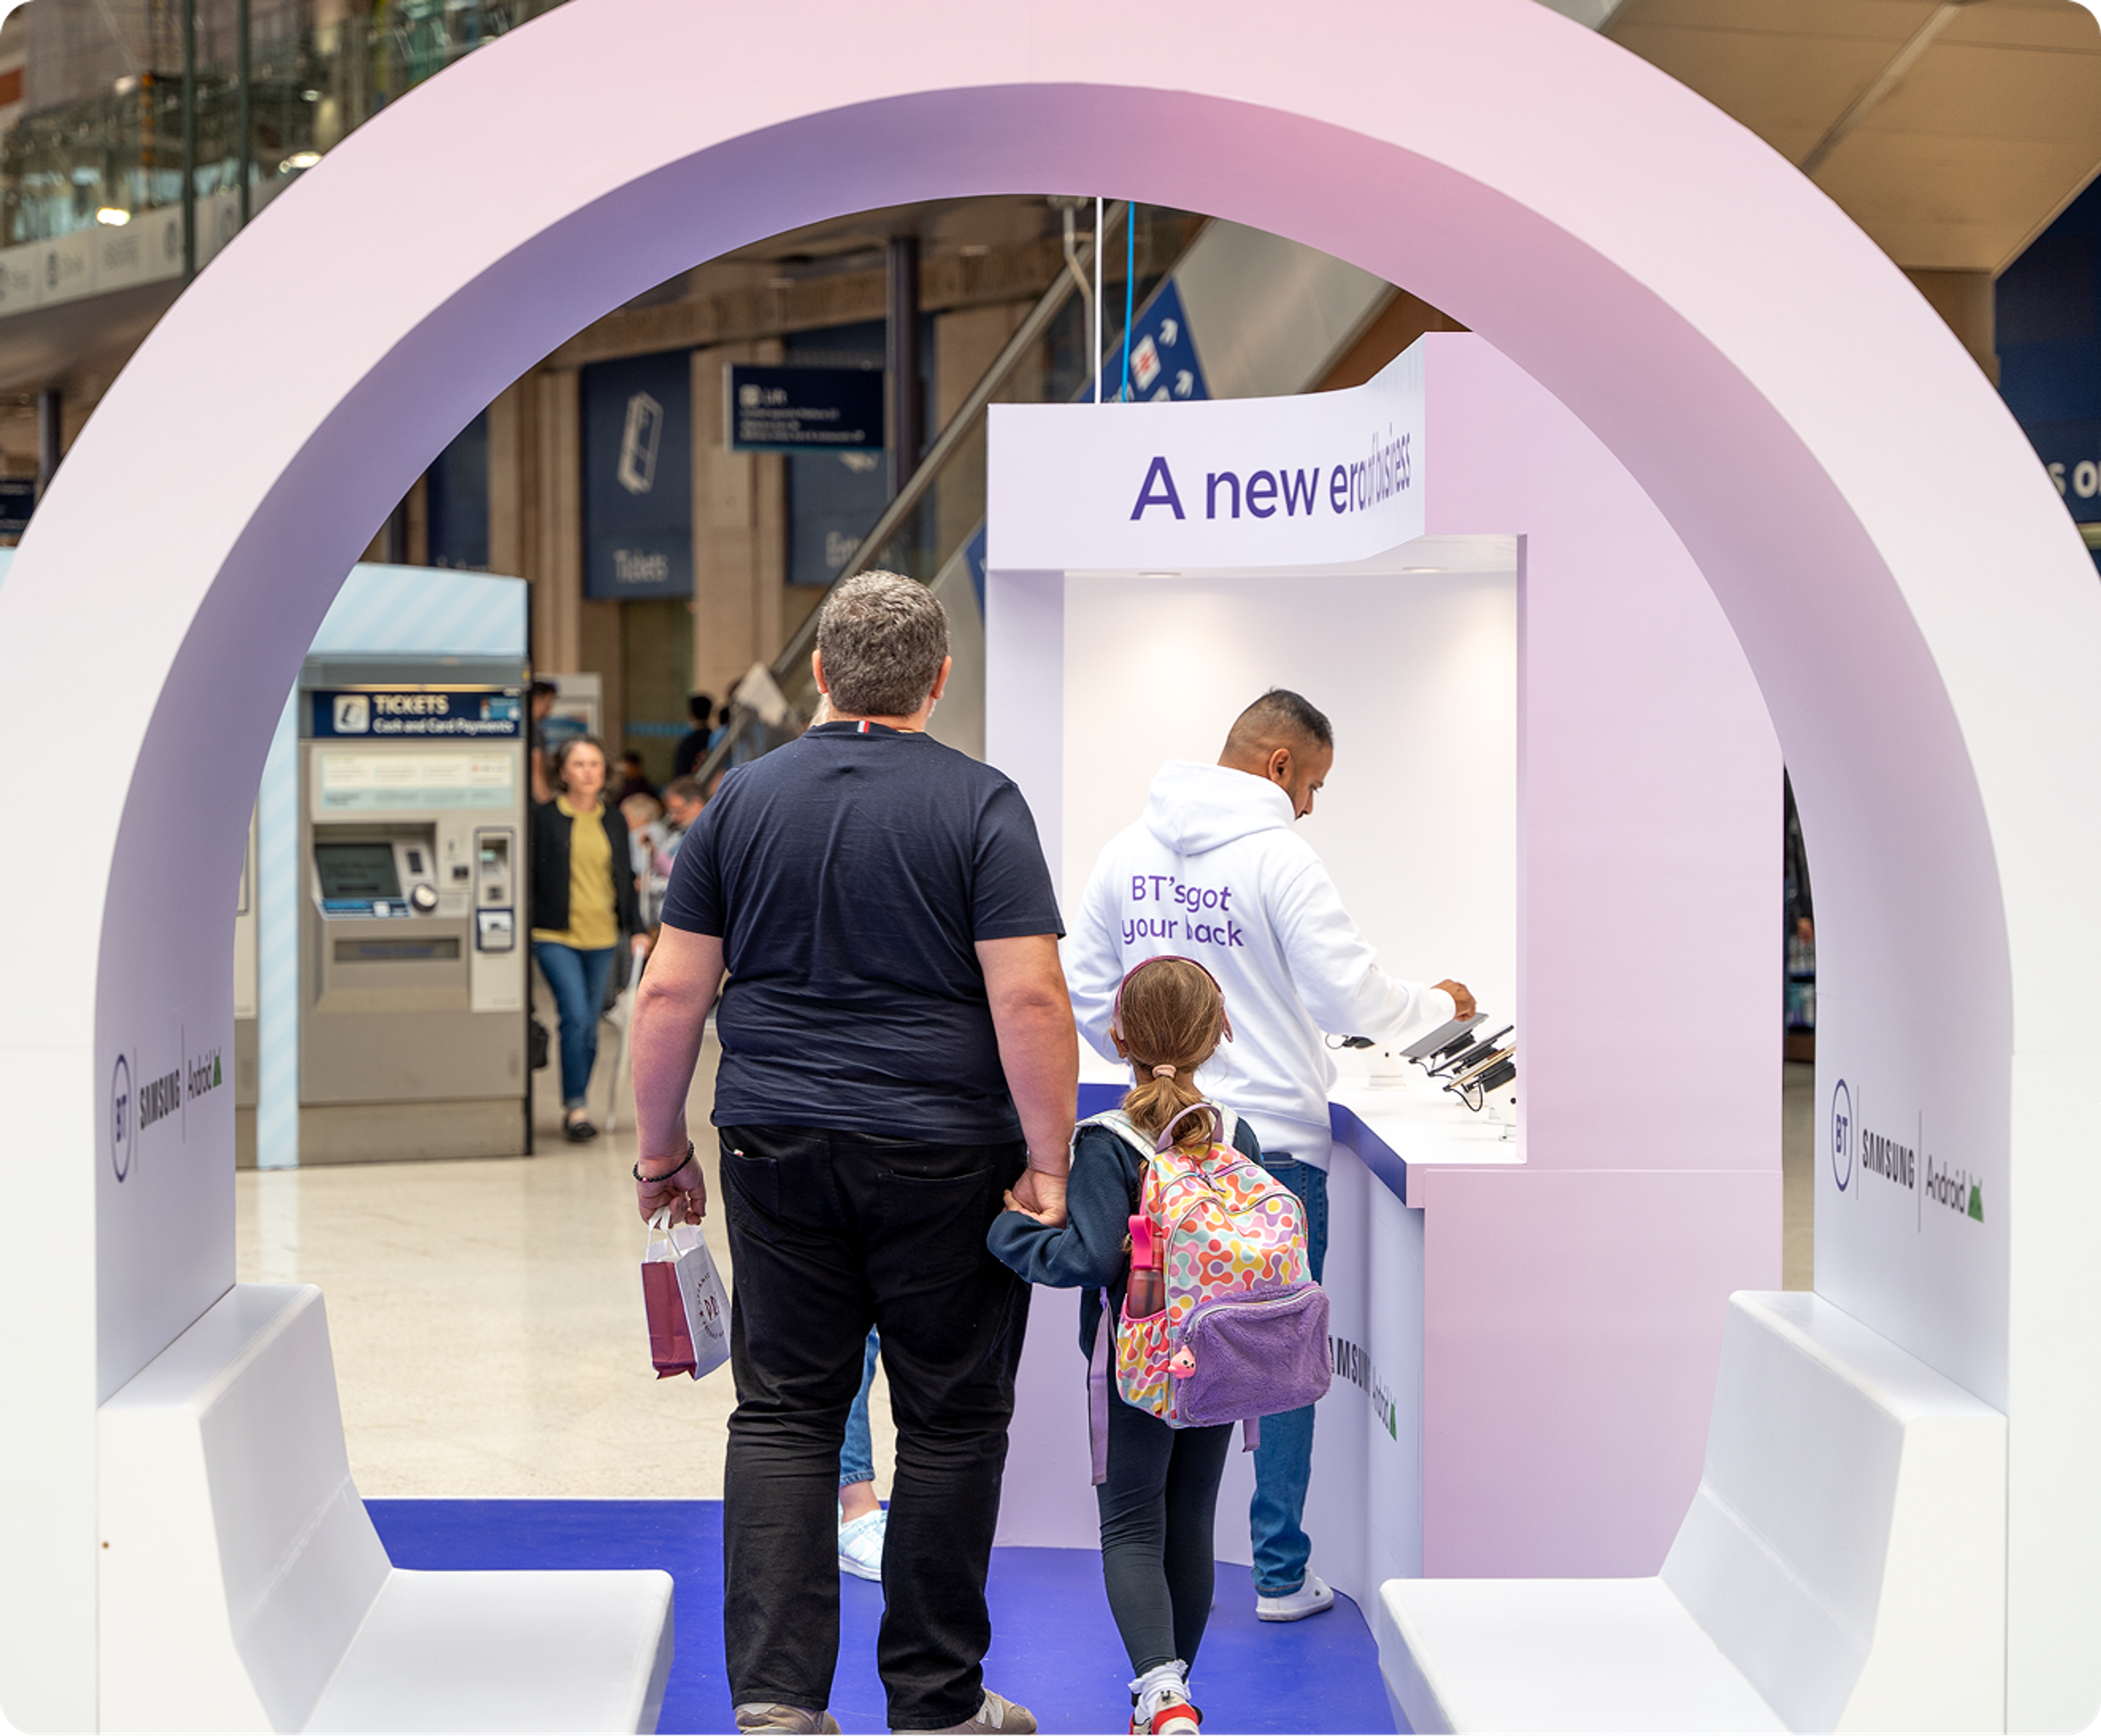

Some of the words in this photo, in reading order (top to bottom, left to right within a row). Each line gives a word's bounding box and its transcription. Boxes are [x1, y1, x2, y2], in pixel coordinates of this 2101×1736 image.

[1129, 456, 1186, 521] A
[1206, 466, 1320, 519] new
[1330, 460, 1366, 515] era
[613, 549, 669, 583] Tickets
[373, 694, 449, 715] TICKETS
[373, 718, 403, 733] Cash
[403, 719, 426, 733] and
[428, 718, 455, 733] Card
[457, 718, 515, 735] Payments
[1122, 919, 1178, 945] your
[140, 1069, 180, 1130] SAMSUNG
[1836, 1114, 1848, 1156] BT
[1862, 1128, 1914, 1190] SAMSUNG
[1925, 1154, 1966, 1214] Android
